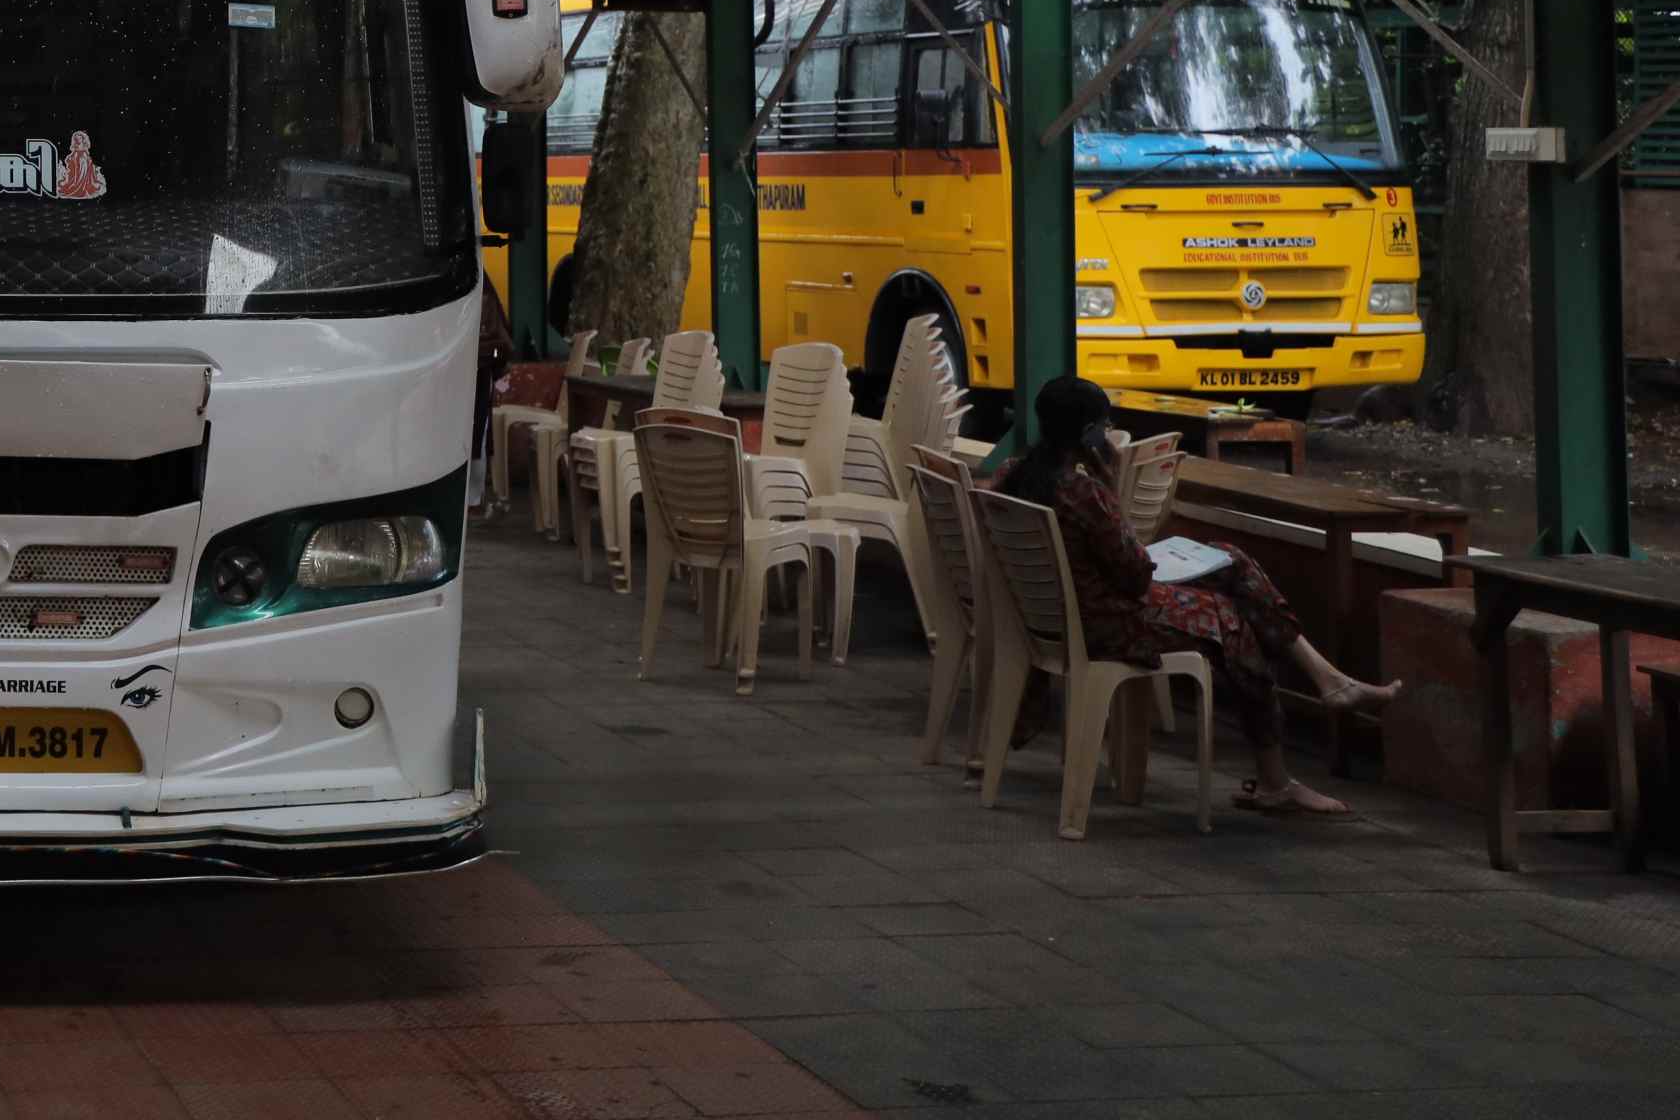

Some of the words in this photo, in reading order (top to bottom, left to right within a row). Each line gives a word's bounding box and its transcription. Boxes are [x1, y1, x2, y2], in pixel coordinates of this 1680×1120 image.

[758, 183, 806, 210] THAPURAM
[1183, 237, 1239, 248] ASHOK
[1246, 236, 1315, 248] LEYLAND
[1200, 371, 1218, 386] KL
[1239, 371, 1256, 386] BL
[1260, 370, 1301, 385] 2459
